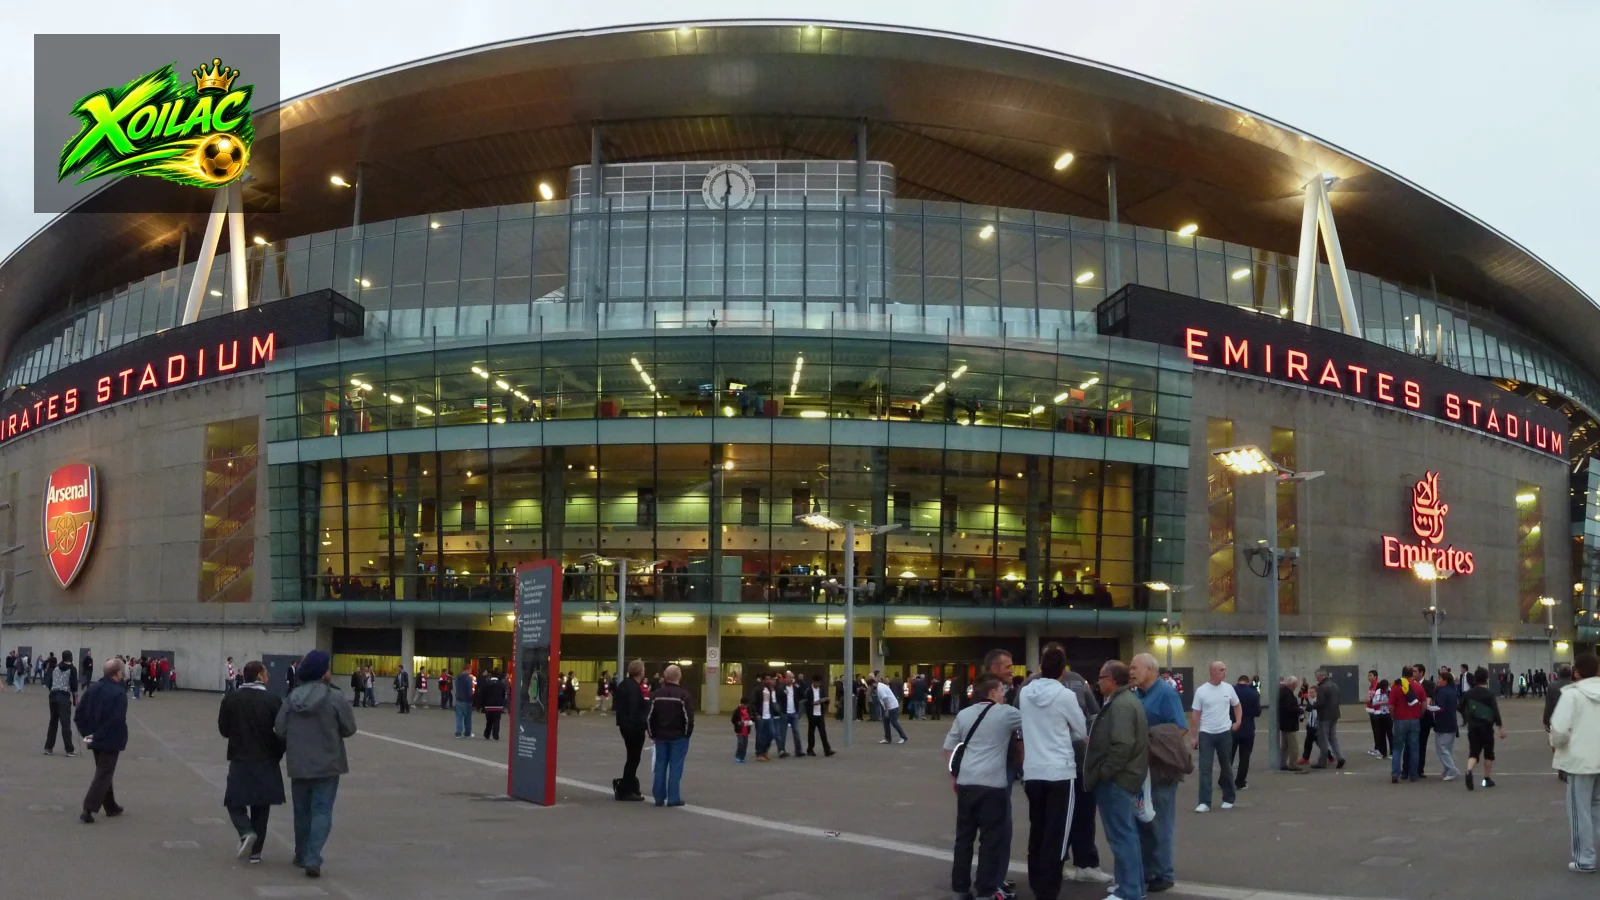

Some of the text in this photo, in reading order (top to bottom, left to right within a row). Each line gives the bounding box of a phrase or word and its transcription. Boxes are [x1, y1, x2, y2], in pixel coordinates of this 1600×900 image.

[97, 332, 274, 403] STADIUM
[1186, 327, 1562, 455] EMIRATES STADIUM
[47, 478, 89, 505] Arsenal
[1382, 535, 1475, 574] Emirates
